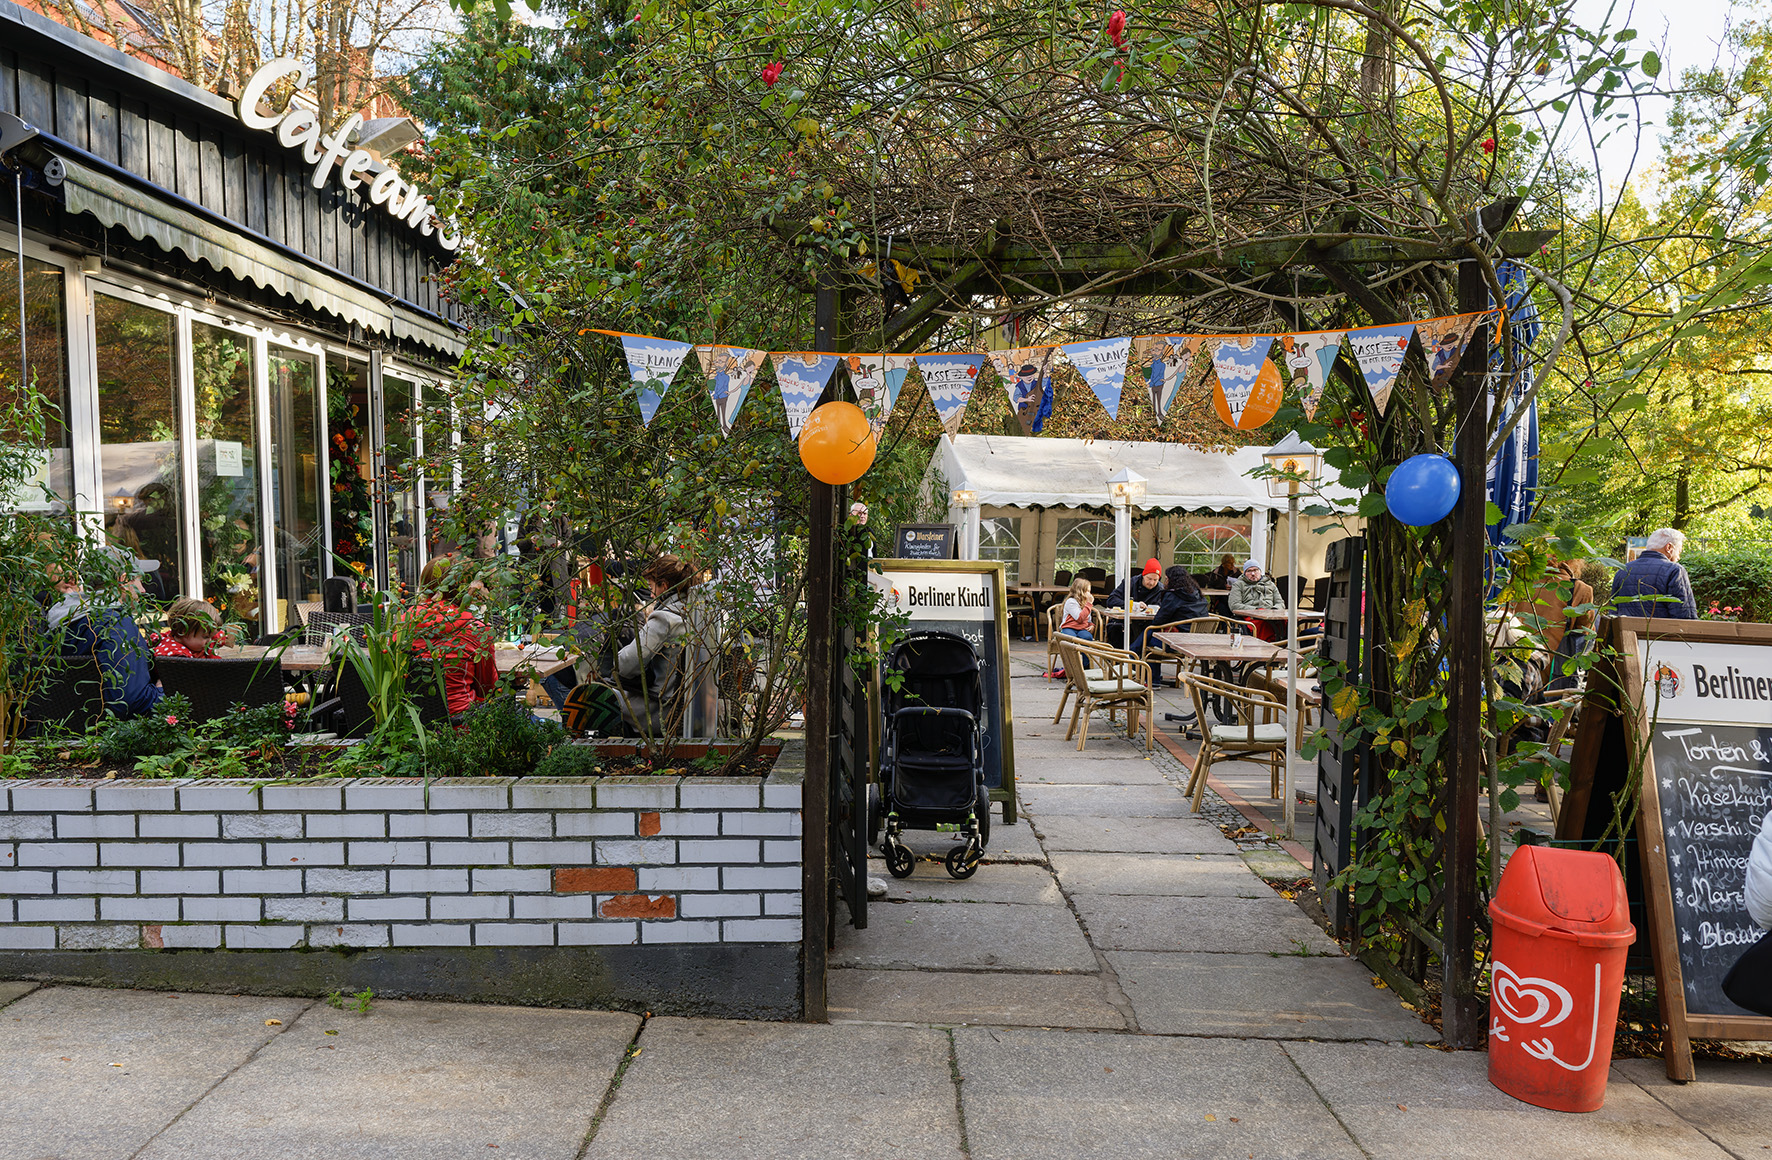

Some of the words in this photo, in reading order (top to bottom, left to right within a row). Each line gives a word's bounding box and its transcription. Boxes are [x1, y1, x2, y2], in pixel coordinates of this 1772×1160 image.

[647, 354, 681, 368] KLANG
[1093, 347, 1128, 363] KLANG
[908, 585, 956, 607] Berliner
[957, 586, 990, 608] Kindl
[1661, 727, 1750, 762] Torten
[1749, 739, 1770, 764] &
[1686, 876, 1746, 907] Marz
